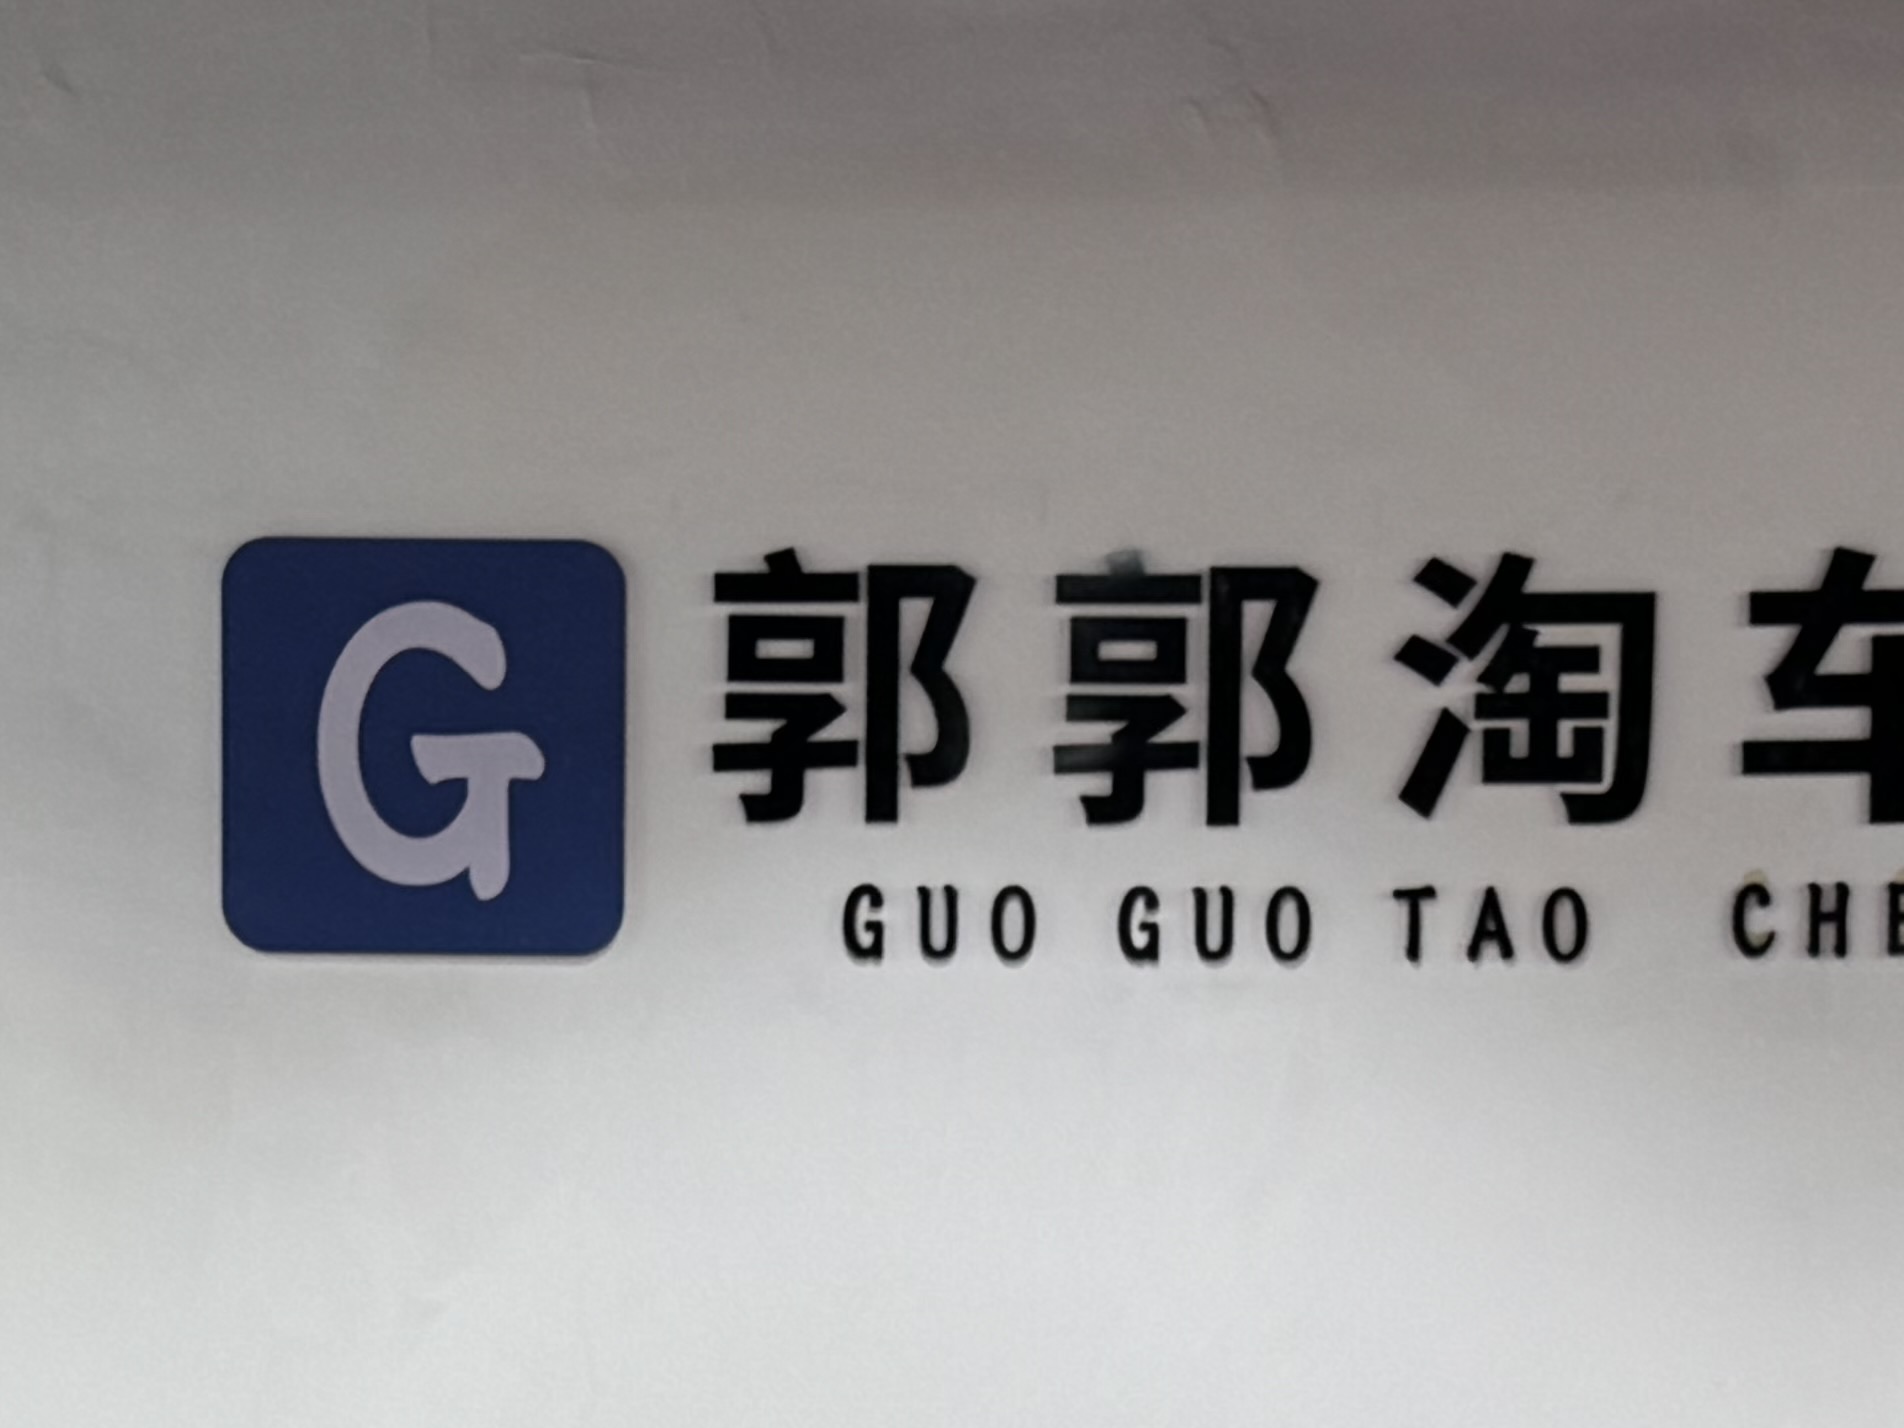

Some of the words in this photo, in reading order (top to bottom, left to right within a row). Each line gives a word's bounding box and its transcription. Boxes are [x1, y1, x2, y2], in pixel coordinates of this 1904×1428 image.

[318, 602, 543, 900] G
[842, 883, 1036, 962] GUO
[1117, 885, 1312, 962] GUO
[1392, 885, 1589, 964] TAO
